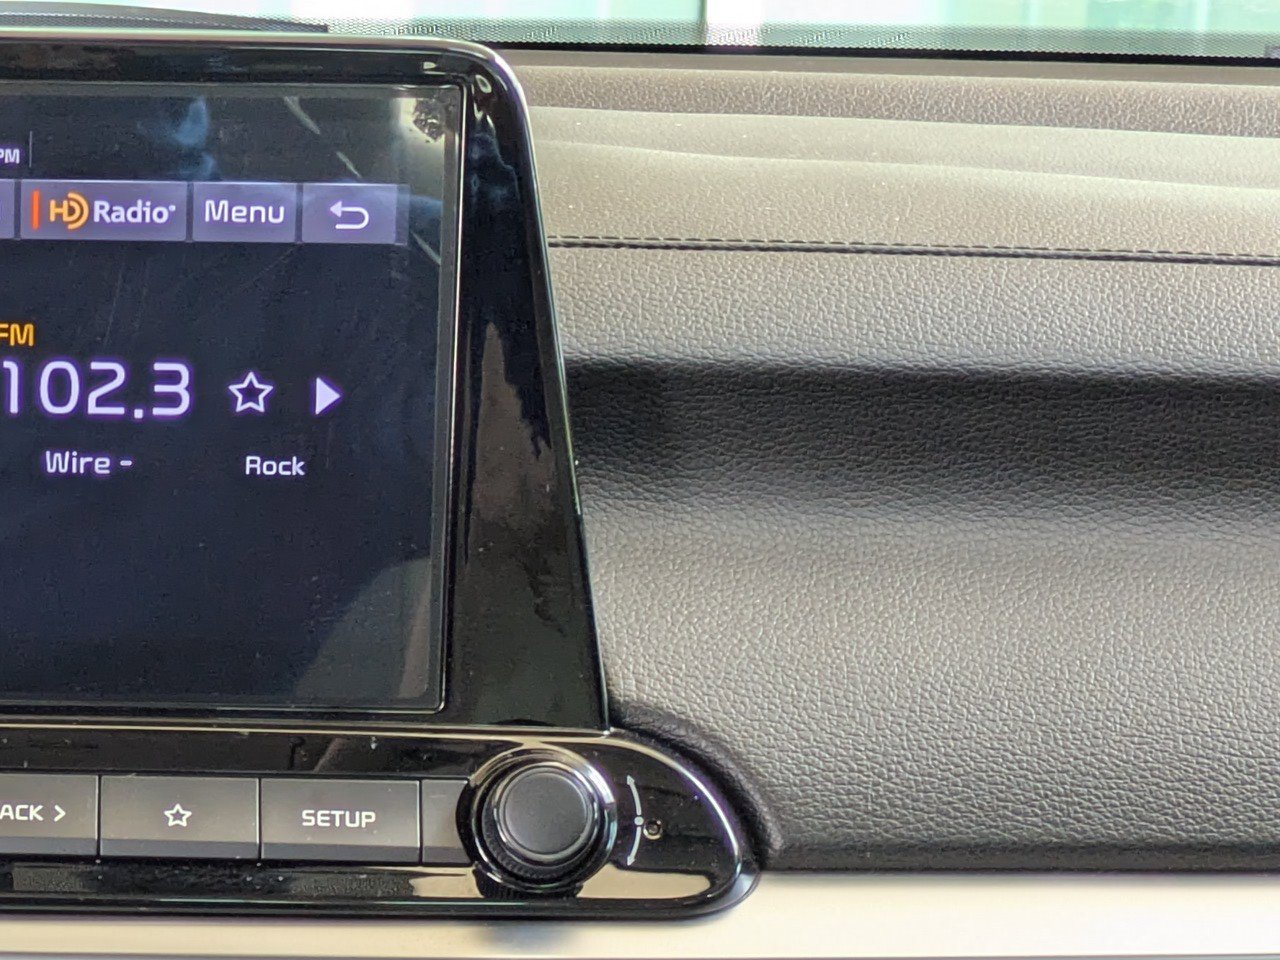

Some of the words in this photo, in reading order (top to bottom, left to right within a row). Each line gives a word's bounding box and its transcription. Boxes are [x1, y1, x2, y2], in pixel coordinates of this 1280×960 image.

[205, 199, 285, 224] Menu
[3, 360, 192, 420] 102.3
[44, 451, 111, 474] Wire
[245, 456, 306, 476] Rock
[301, 809, 376, 829] SETUP
